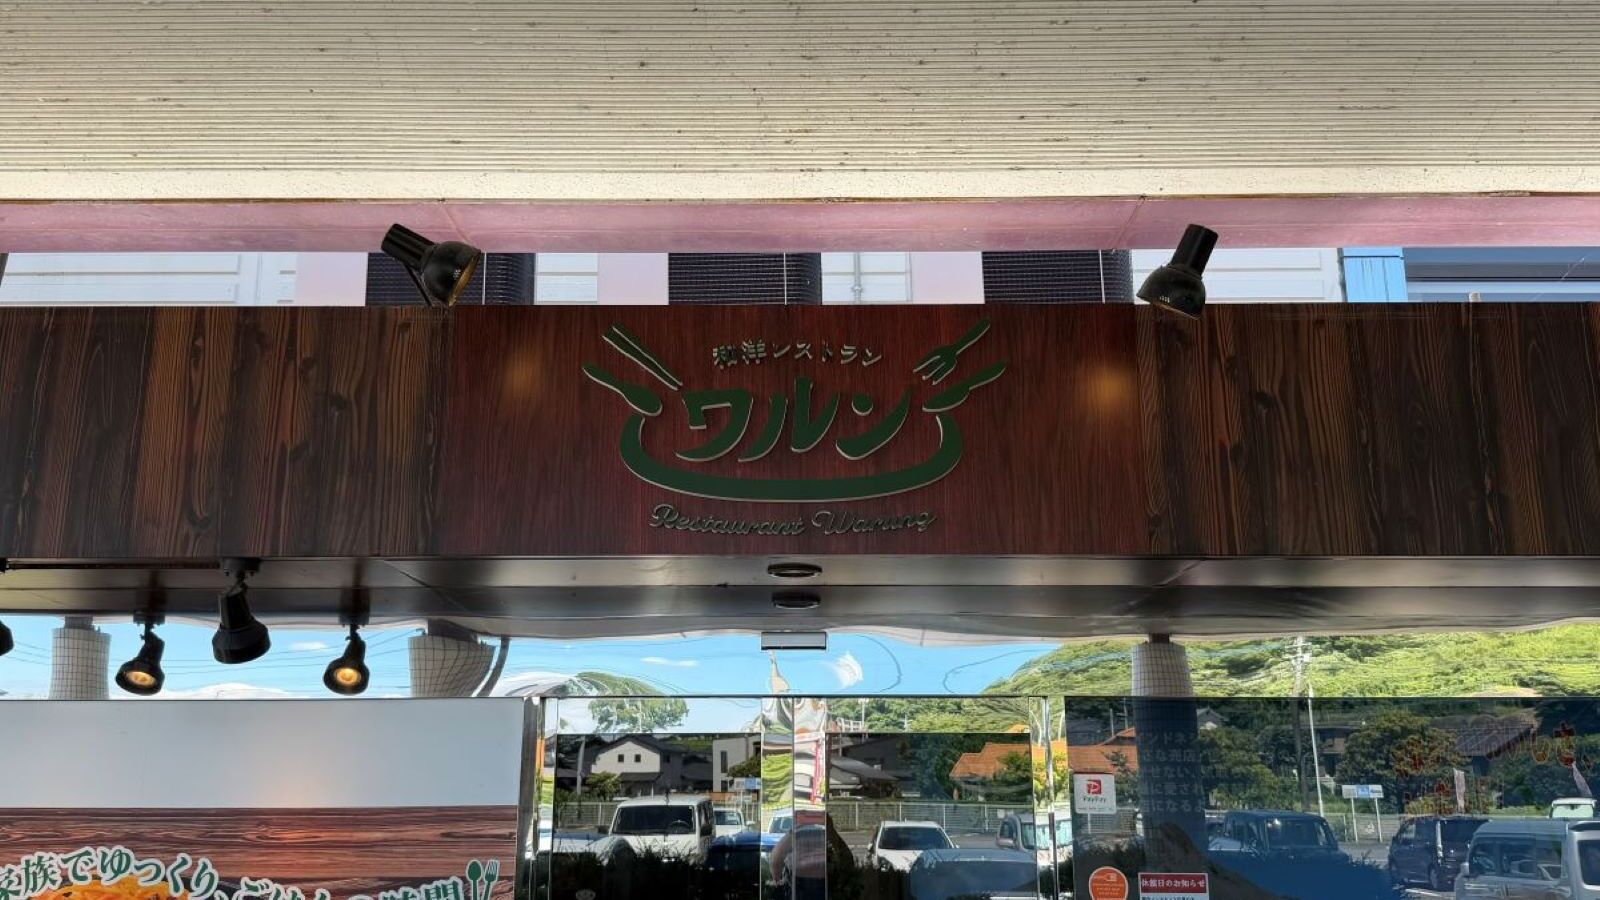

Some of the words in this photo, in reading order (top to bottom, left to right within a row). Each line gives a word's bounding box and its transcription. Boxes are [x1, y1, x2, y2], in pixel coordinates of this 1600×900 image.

[711, 337, 883, 369] 和洋レストラン
[675, 377, 914, 462] ワルン
[649, 503, 806, 536] Restaurant
[811, 507, 937, 537] Warung
